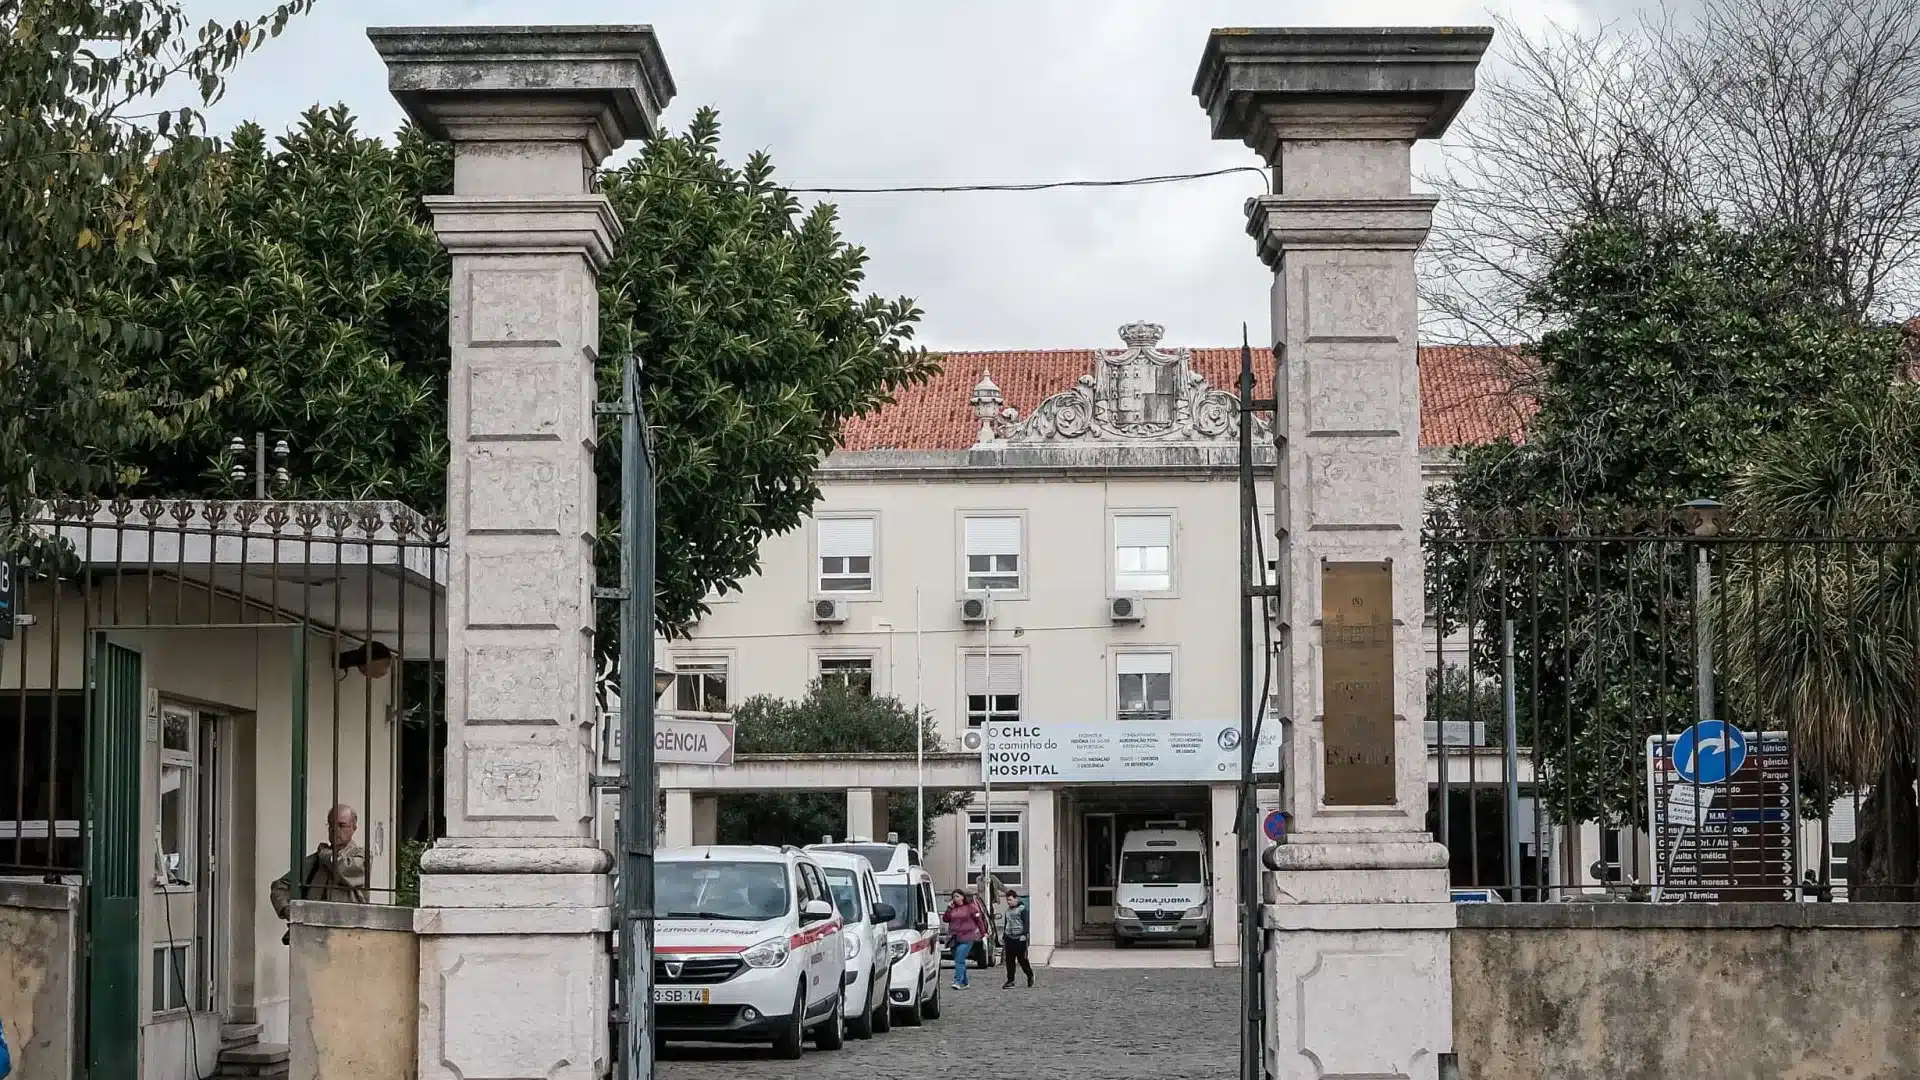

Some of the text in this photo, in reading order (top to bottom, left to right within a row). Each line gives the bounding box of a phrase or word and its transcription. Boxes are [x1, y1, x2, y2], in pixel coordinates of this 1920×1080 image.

[988, 726, 1042, 738] O CHLC
[614, 728, 708, 753] EGÊNCIA
[998, 738, 1042, 751] caminho
[1044, 738, 1058, 750] do
[1748, 744, 1787, 753] Peiátrico
[988, 752, 1031, 763] NOVO
[988, 765, 1059, 775] HOSPITAL
[1762, 771, 1789, 780] Parque
[1689, 890, 1718, 899] Térmica
